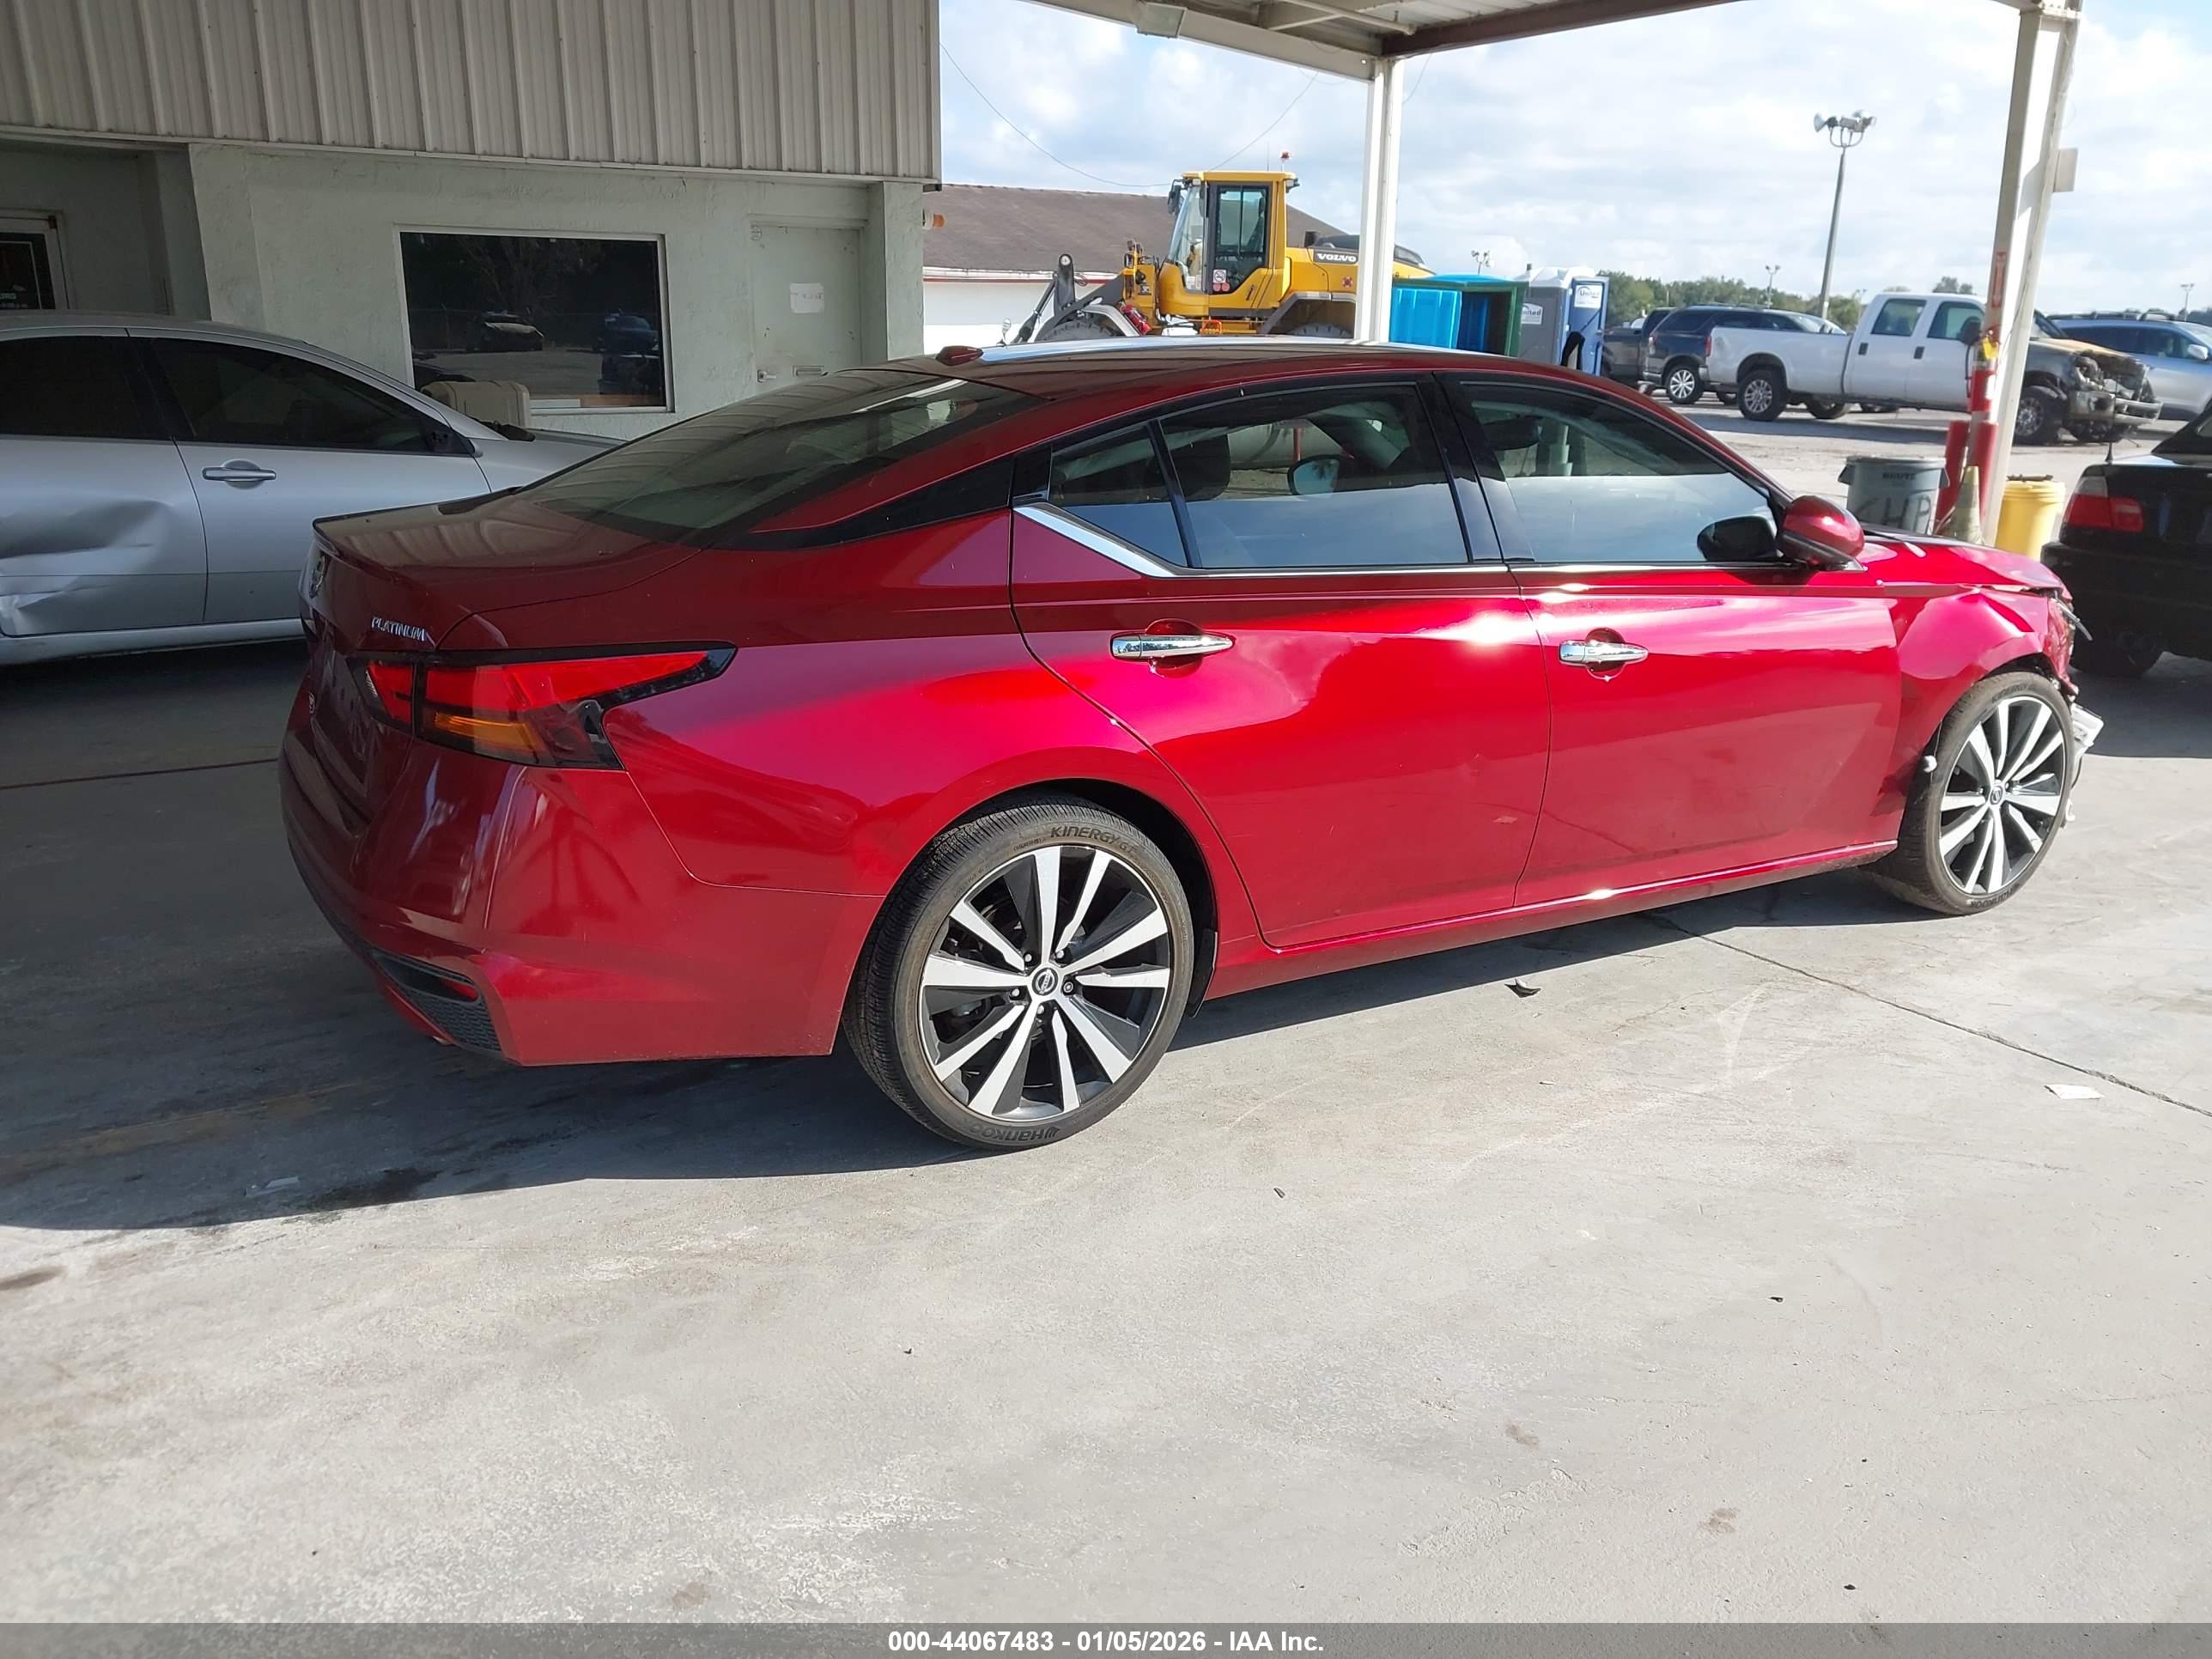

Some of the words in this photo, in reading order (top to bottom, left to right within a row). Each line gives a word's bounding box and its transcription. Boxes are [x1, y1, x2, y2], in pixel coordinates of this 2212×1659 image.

[1316, 253, 1357, 262] VOLVO
[1522, 308, 1541, 317] nited
[371, 617, 426, 641] PLATINUM
[1050, 826, 1121, 843] KINERGY
[1119, 842, 1139, 854] GT
